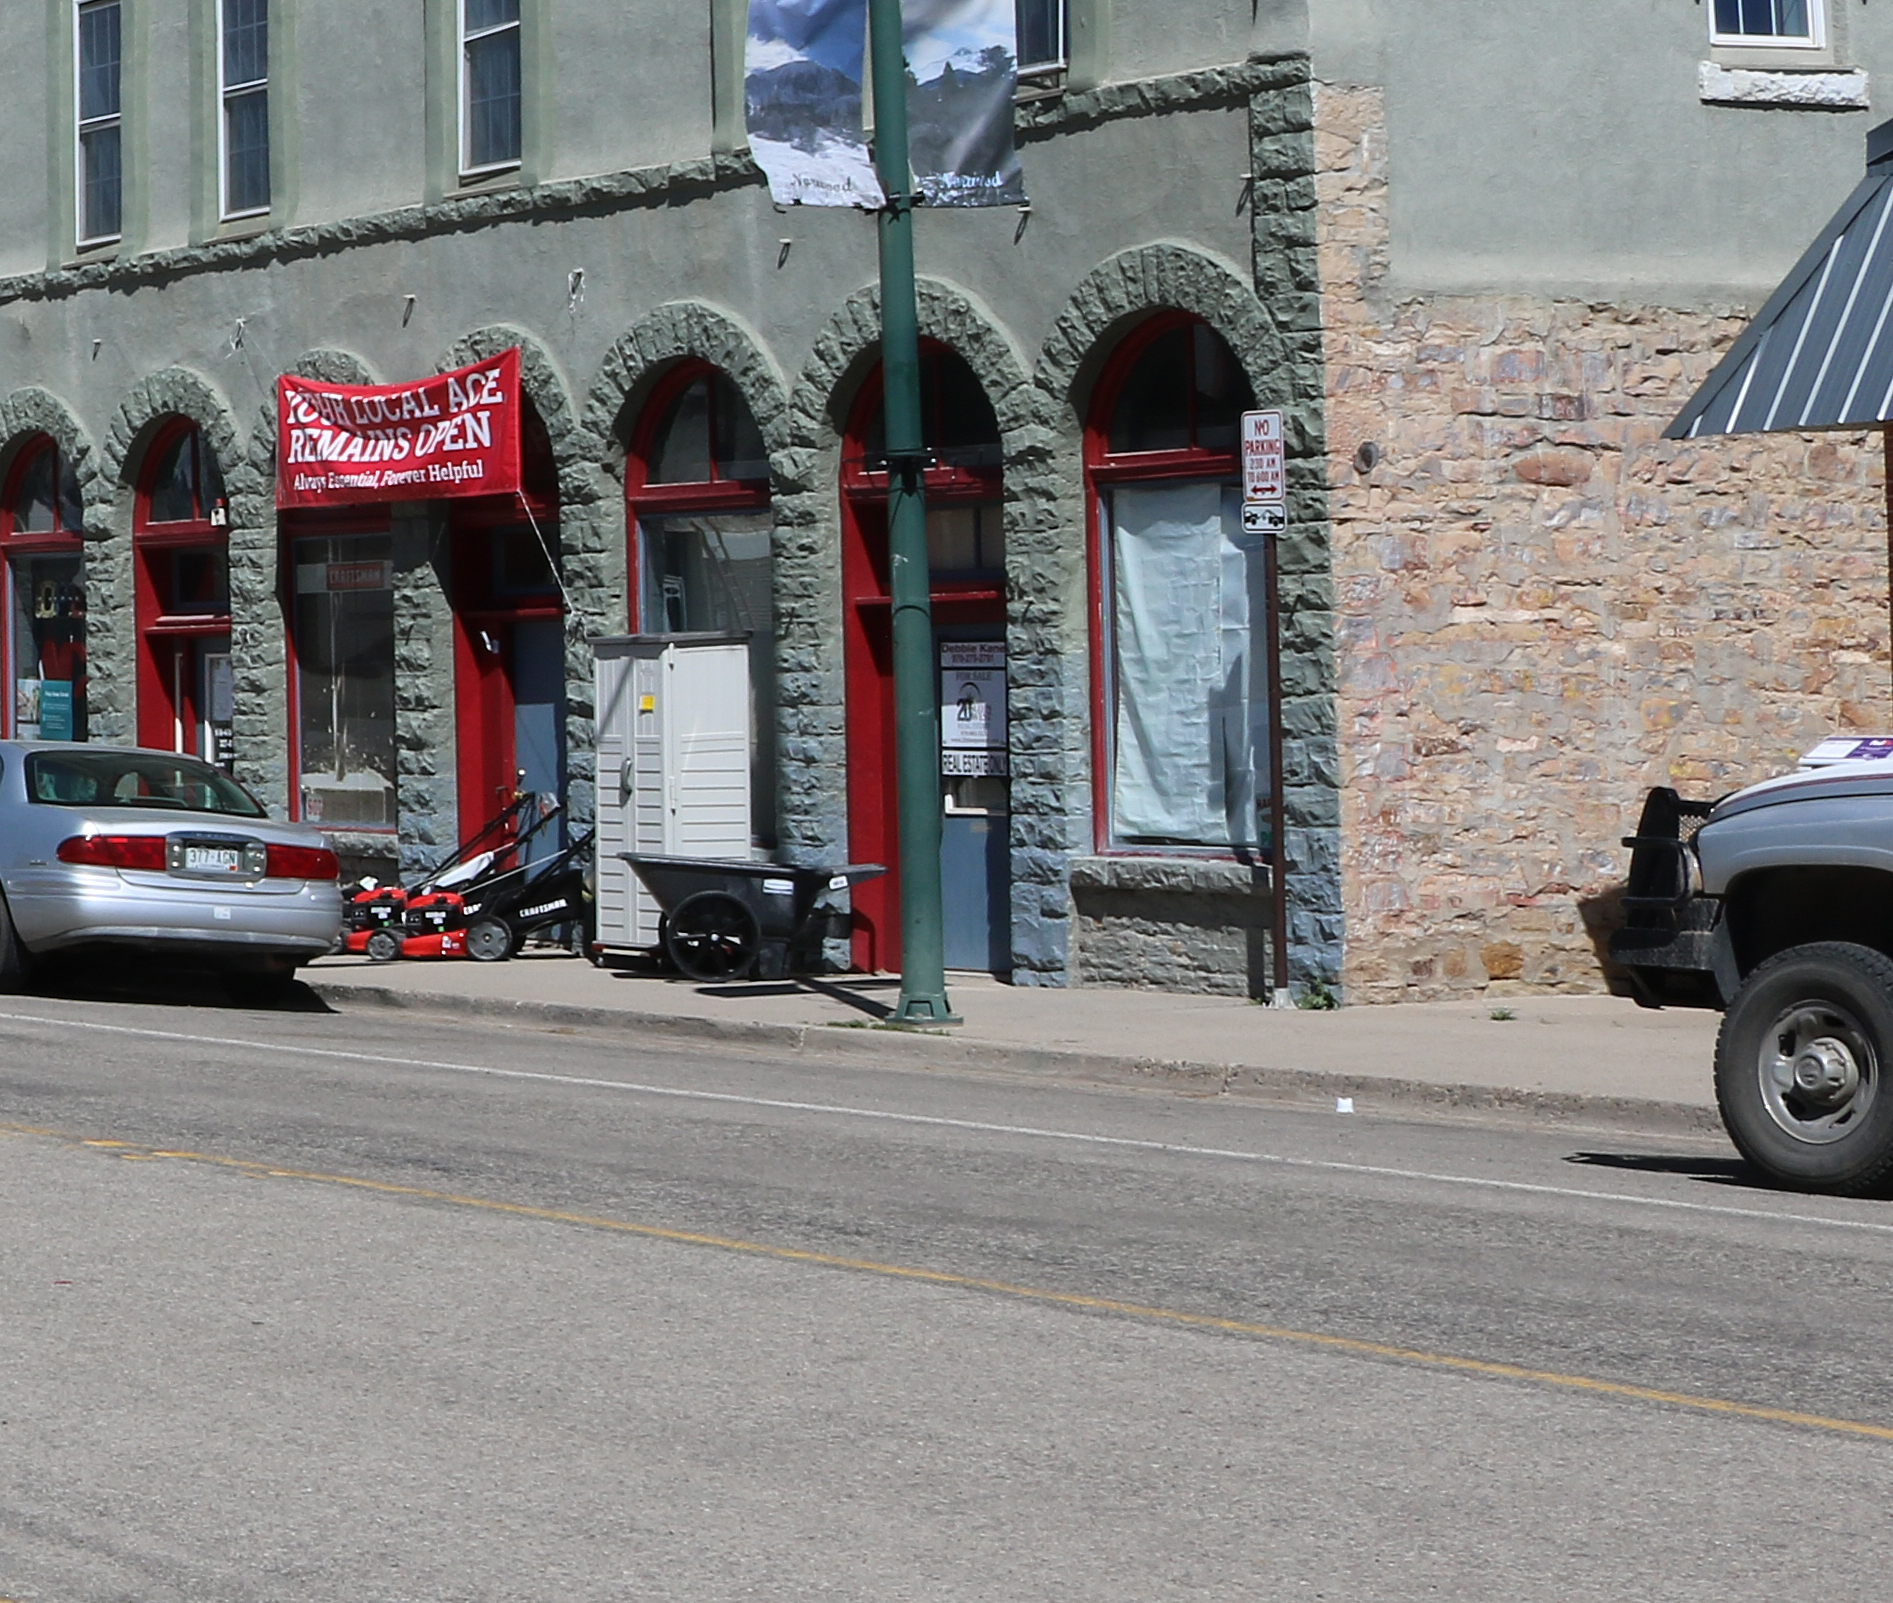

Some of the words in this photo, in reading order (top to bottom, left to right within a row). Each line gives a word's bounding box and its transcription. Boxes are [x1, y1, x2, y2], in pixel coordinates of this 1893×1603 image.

[285, 387, 350, 426] YOUR
[350, 387, 441, 424] LOCAL
[447, 368, 504, 414] ACE
[288, 427, 411, 464] REMAINS
[414, 410, 493, 458] OPEN
[1254, 419, 1269, 436] NO
[1245, 439, 1280, 455] PARKING
[294, 473, 327, 493] Always
[380, 467, 426, 486] Forever
[429, 459, 484, 484] Helpful
[942, 753, 962, 773] REAL
[962, 753, 988, 773] ESTATE
